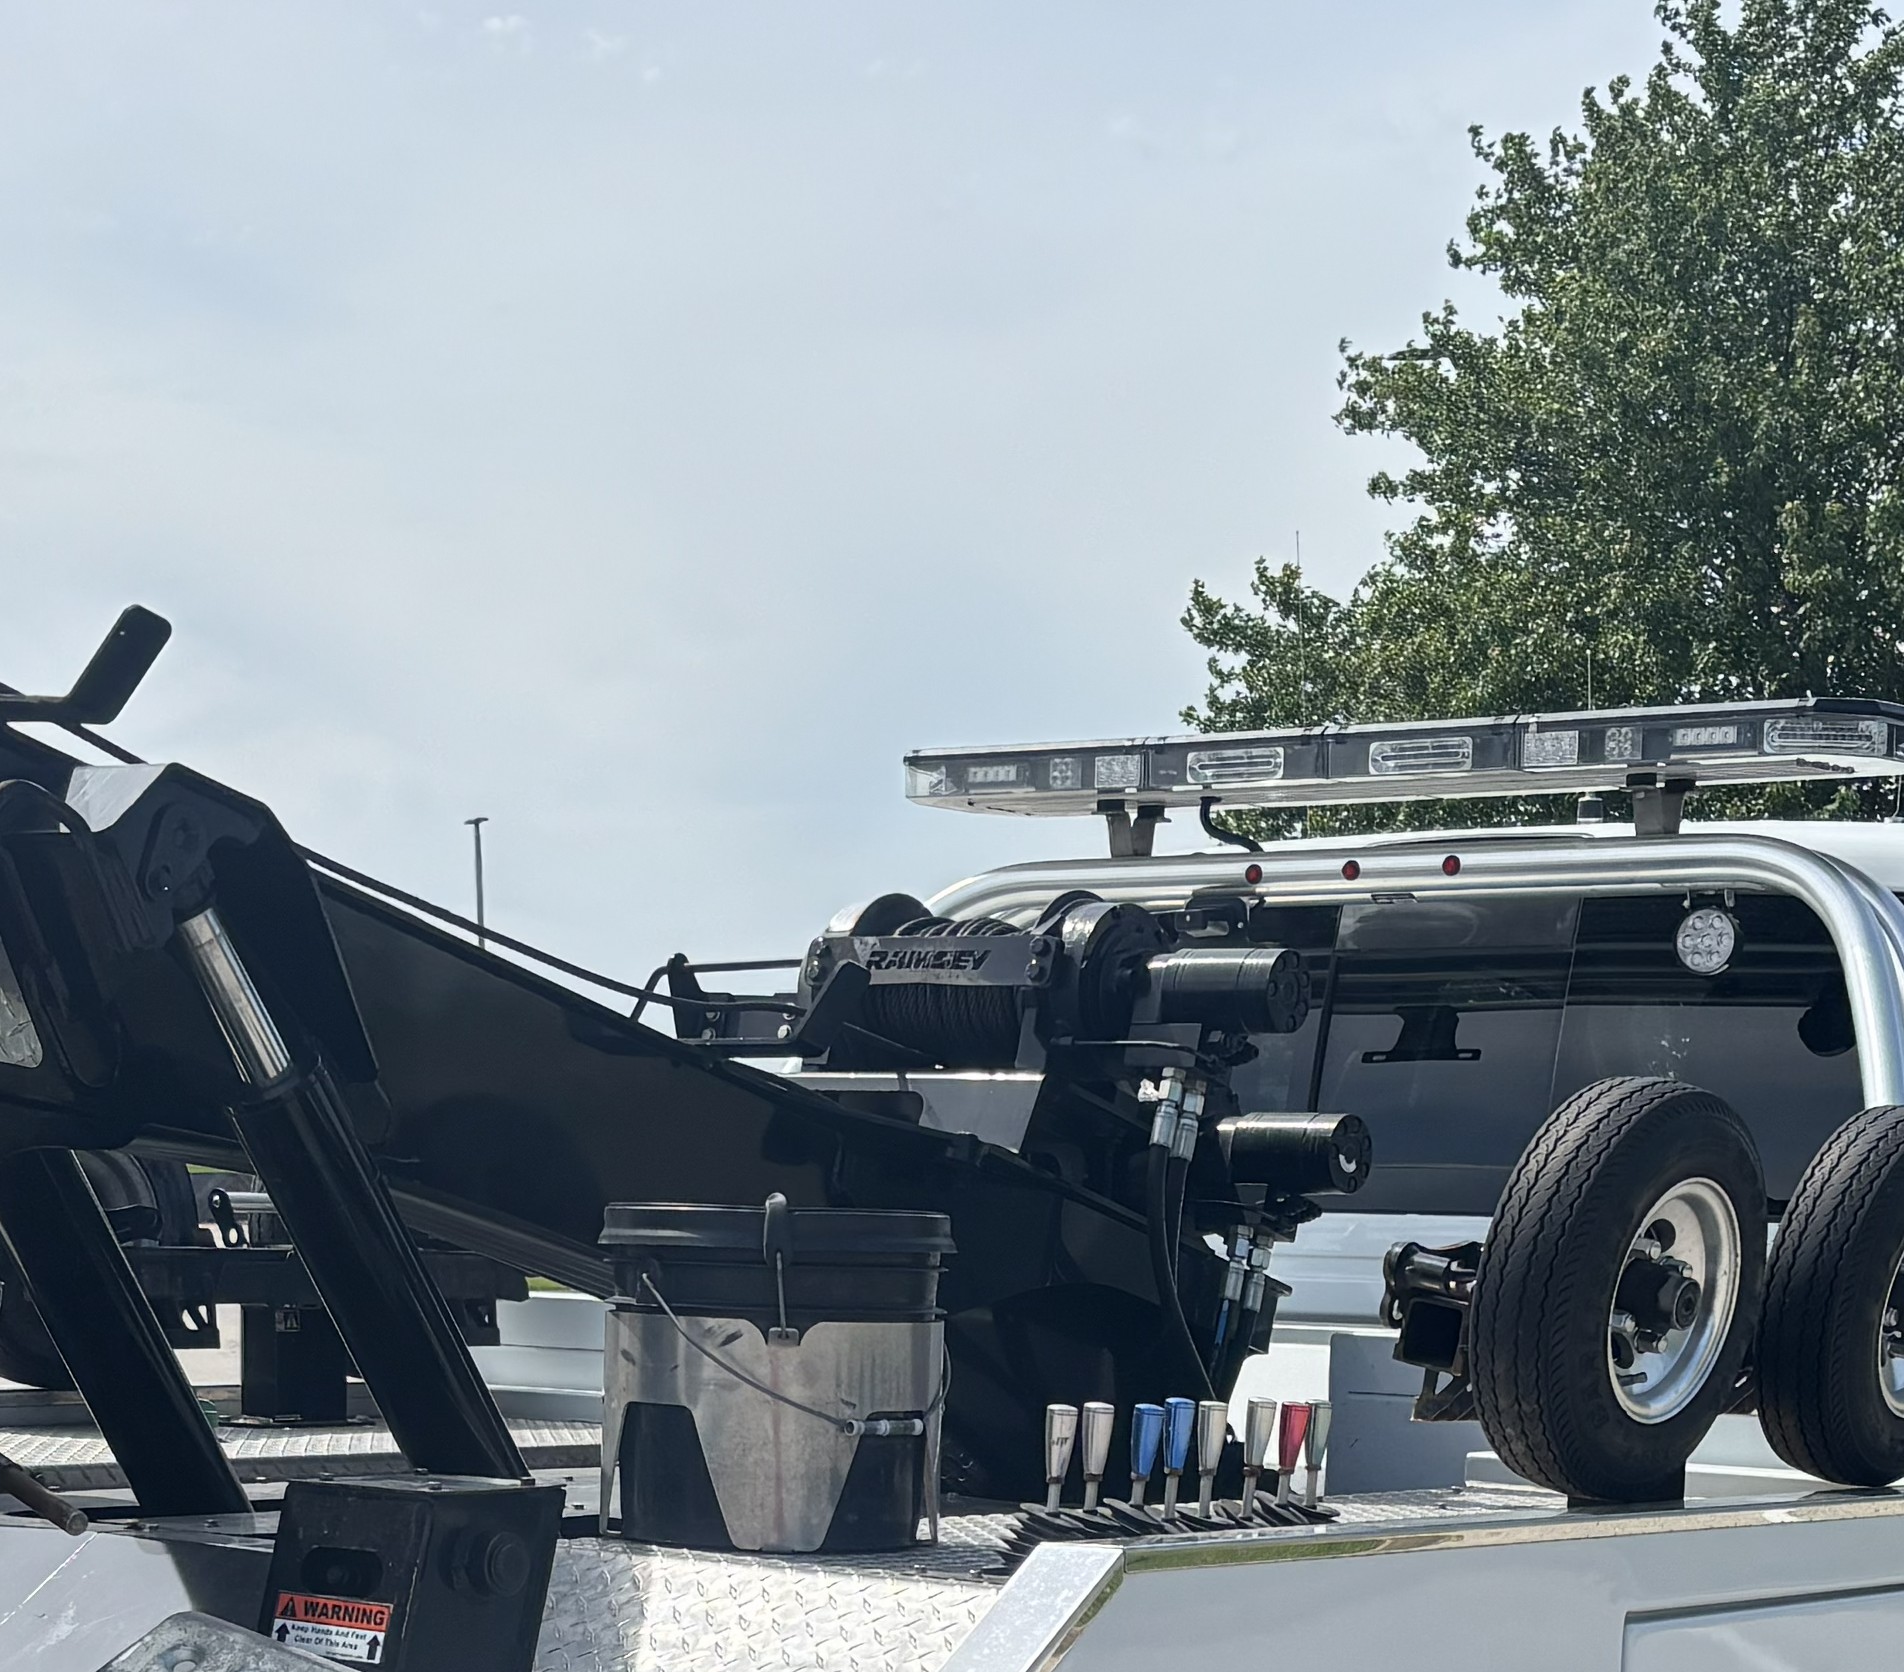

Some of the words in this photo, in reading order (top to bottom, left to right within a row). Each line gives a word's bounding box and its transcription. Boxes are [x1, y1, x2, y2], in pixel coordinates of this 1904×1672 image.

[866, 949, 992, 971] RAMSEY
[304, 1600, 385, 1626] WARNING
[294, 1634, 312, 1644] Clear
[314, 1637, 324, 1645] Of
[325, 1638, 339, 1648] This
[341, 1641, 358, 1651] Area
[311, 1626, 333, 1636] Hands
[335, 1629, 349, 1638] And
[351, 1631, 367, 1640] Feet
